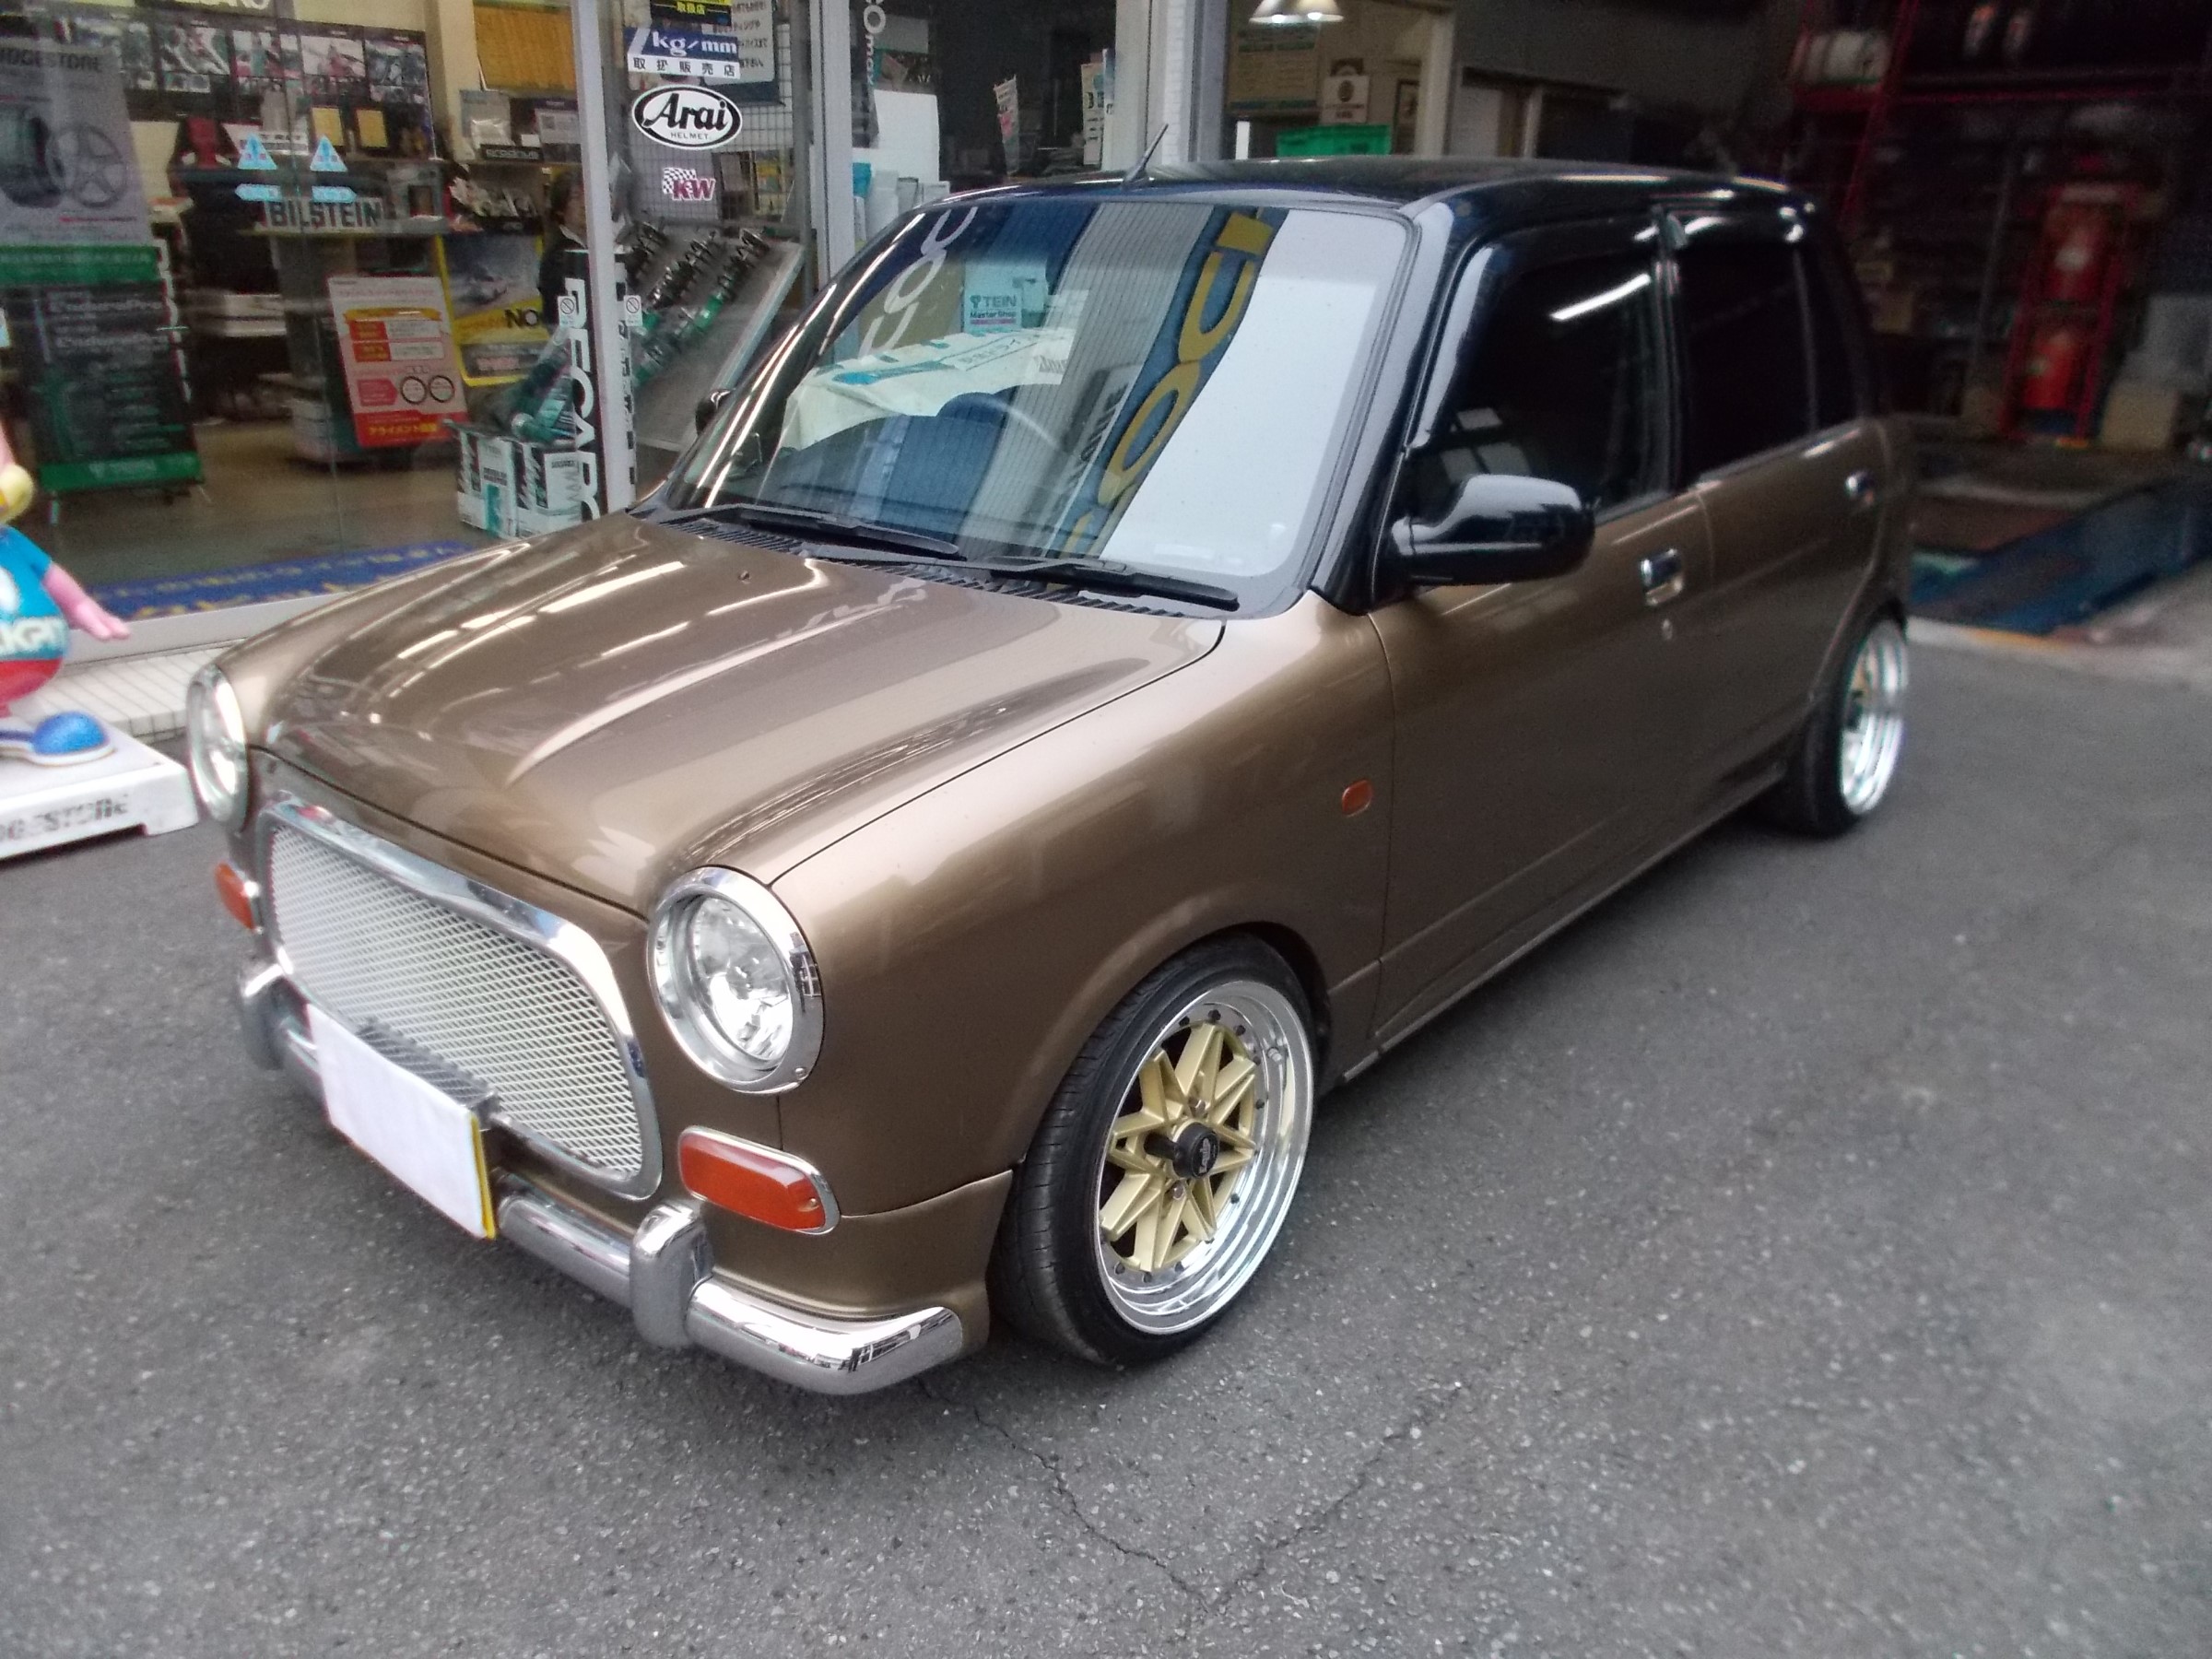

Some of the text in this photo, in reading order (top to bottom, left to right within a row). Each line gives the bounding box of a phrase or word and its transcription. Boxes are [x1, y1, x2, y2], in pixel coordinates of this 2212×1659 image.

[652, 30, 737, 57] kg/mm
[632, 56, 736, 77] 取扱販売店
[641, 92, 728, 132] Arai
[670, 131, 709, 140] HELMET
[673, 178, 716, 201] KW
[269, 201, 382, 228] BILSTEIN
[982, 295, 1017, 308] TEIN
